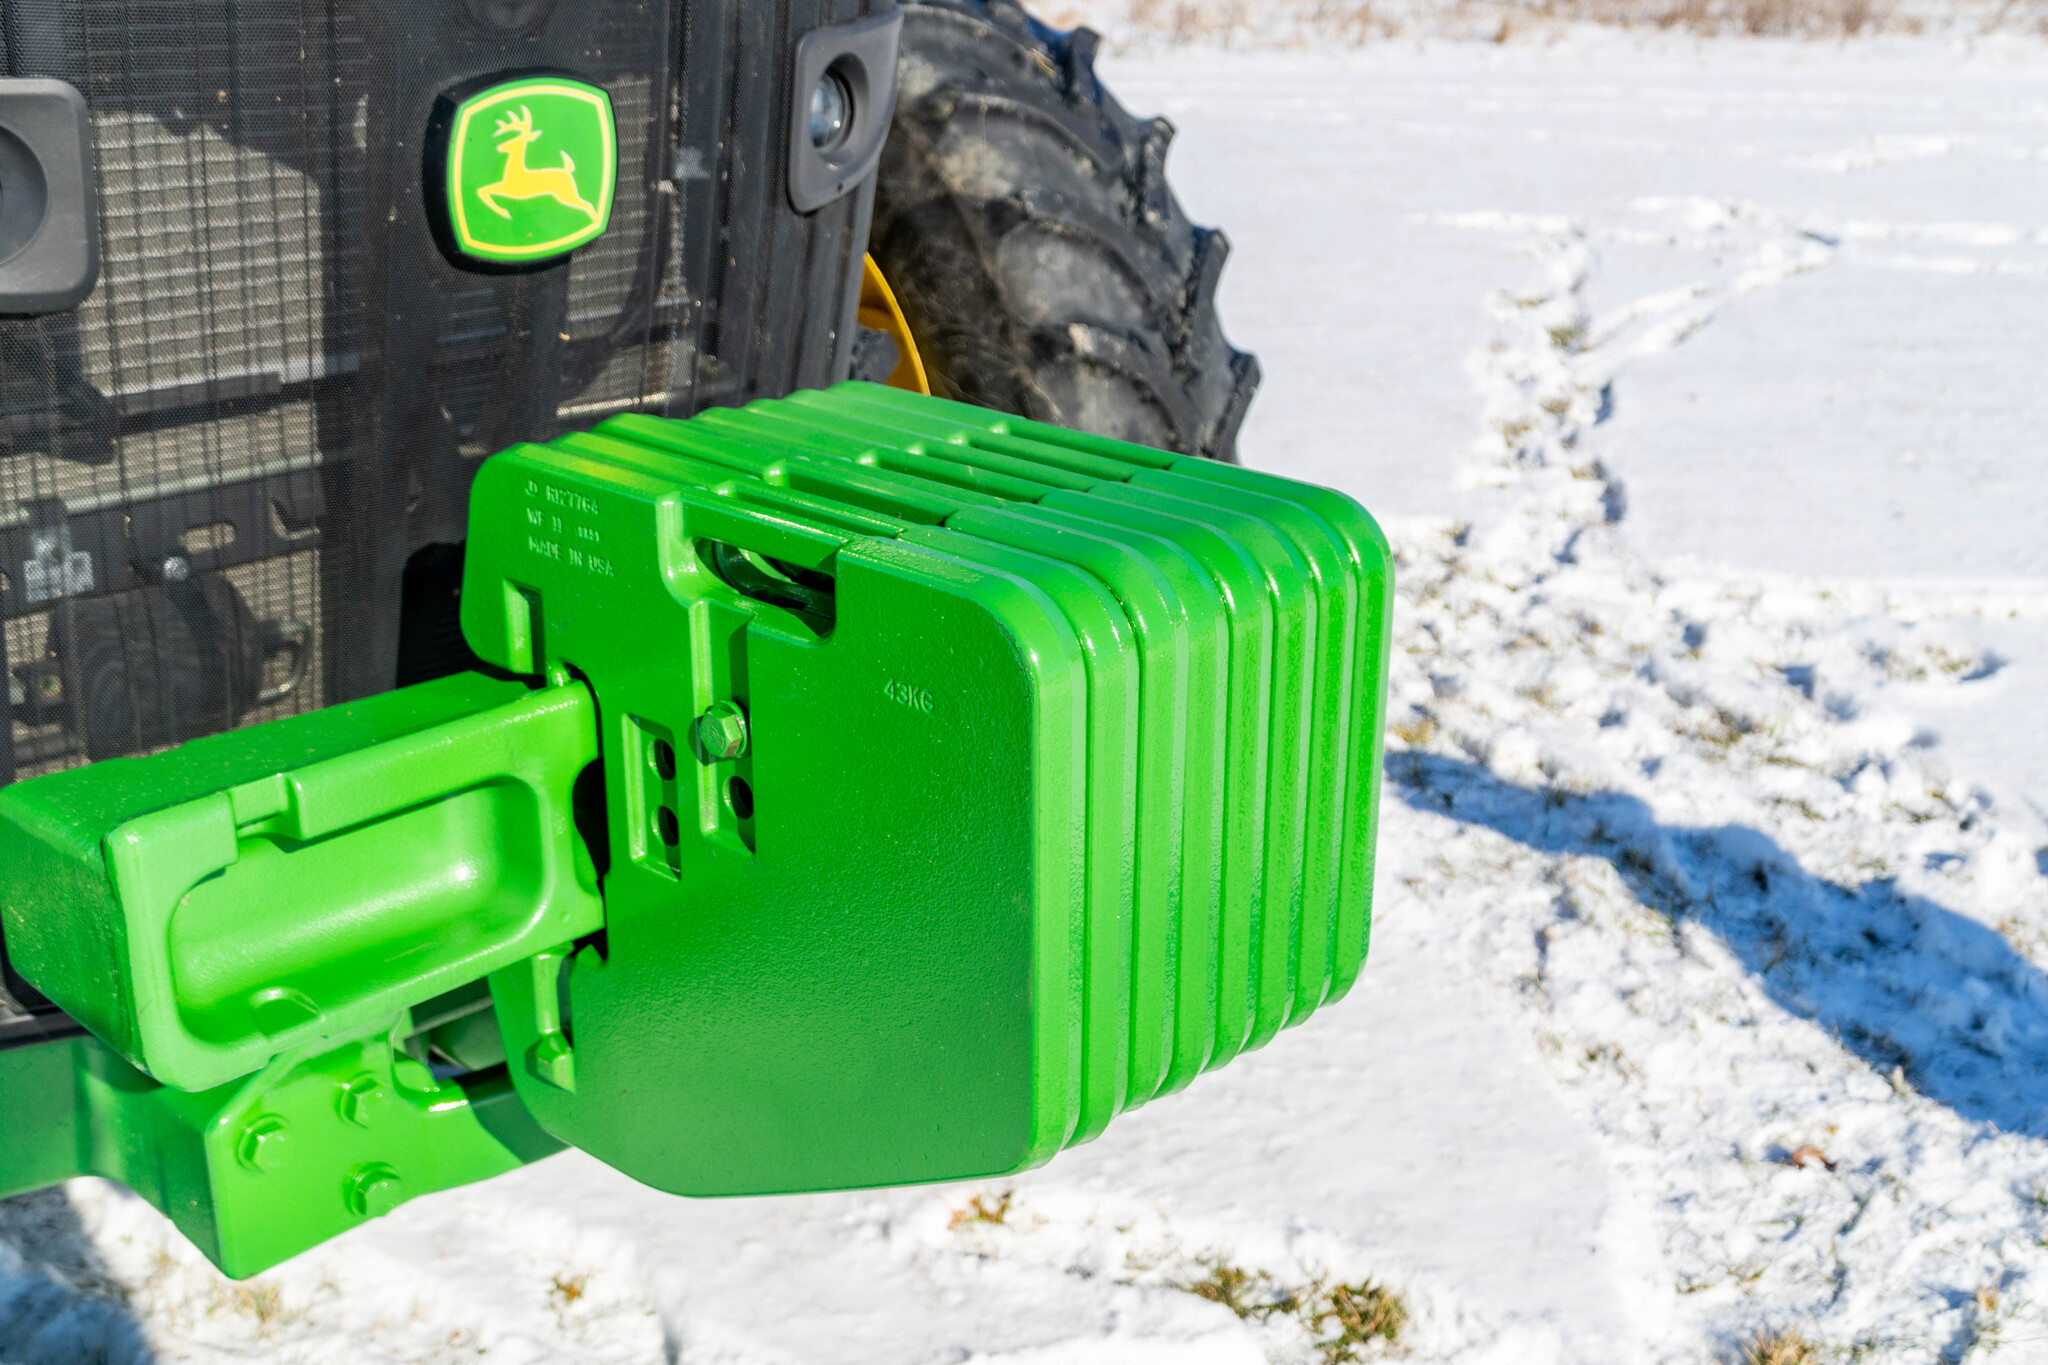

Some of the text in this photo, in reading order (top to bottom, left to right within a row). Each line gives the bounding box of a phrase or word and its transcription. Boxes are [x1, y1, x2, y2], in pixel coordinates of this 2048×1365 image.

[528, 535, 615, 577] MADE IN USA
[884, 678, 934, 713] 43KG
